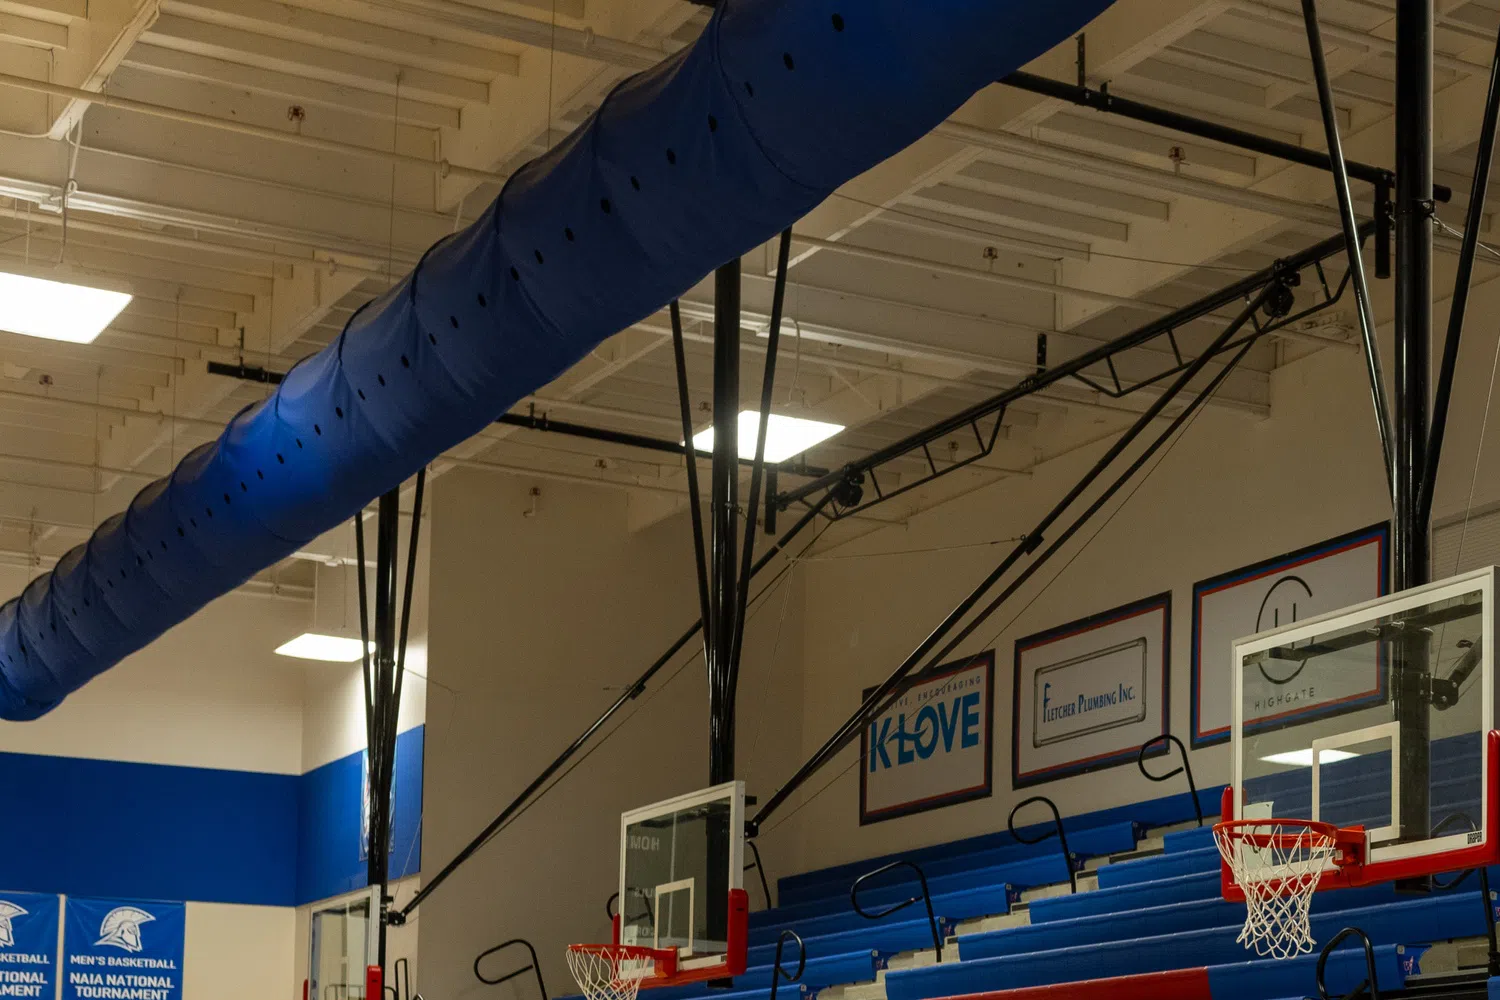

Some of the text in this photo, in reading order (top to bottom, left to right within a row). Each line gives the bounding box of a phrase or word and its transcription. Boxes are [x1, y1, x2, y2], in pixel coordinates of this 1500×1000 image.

[917, 675, 981, 702] ENCOURAGING
[1254, 686, 1315, 712] HIGHGATE
[1043, 682, 1136, 723] FLETCHER PLUMBING INC.
[70, 954, 177, 970] MEN'S BASKETBALL
[70, 972, 175, 988] NAIA NATIONAL
